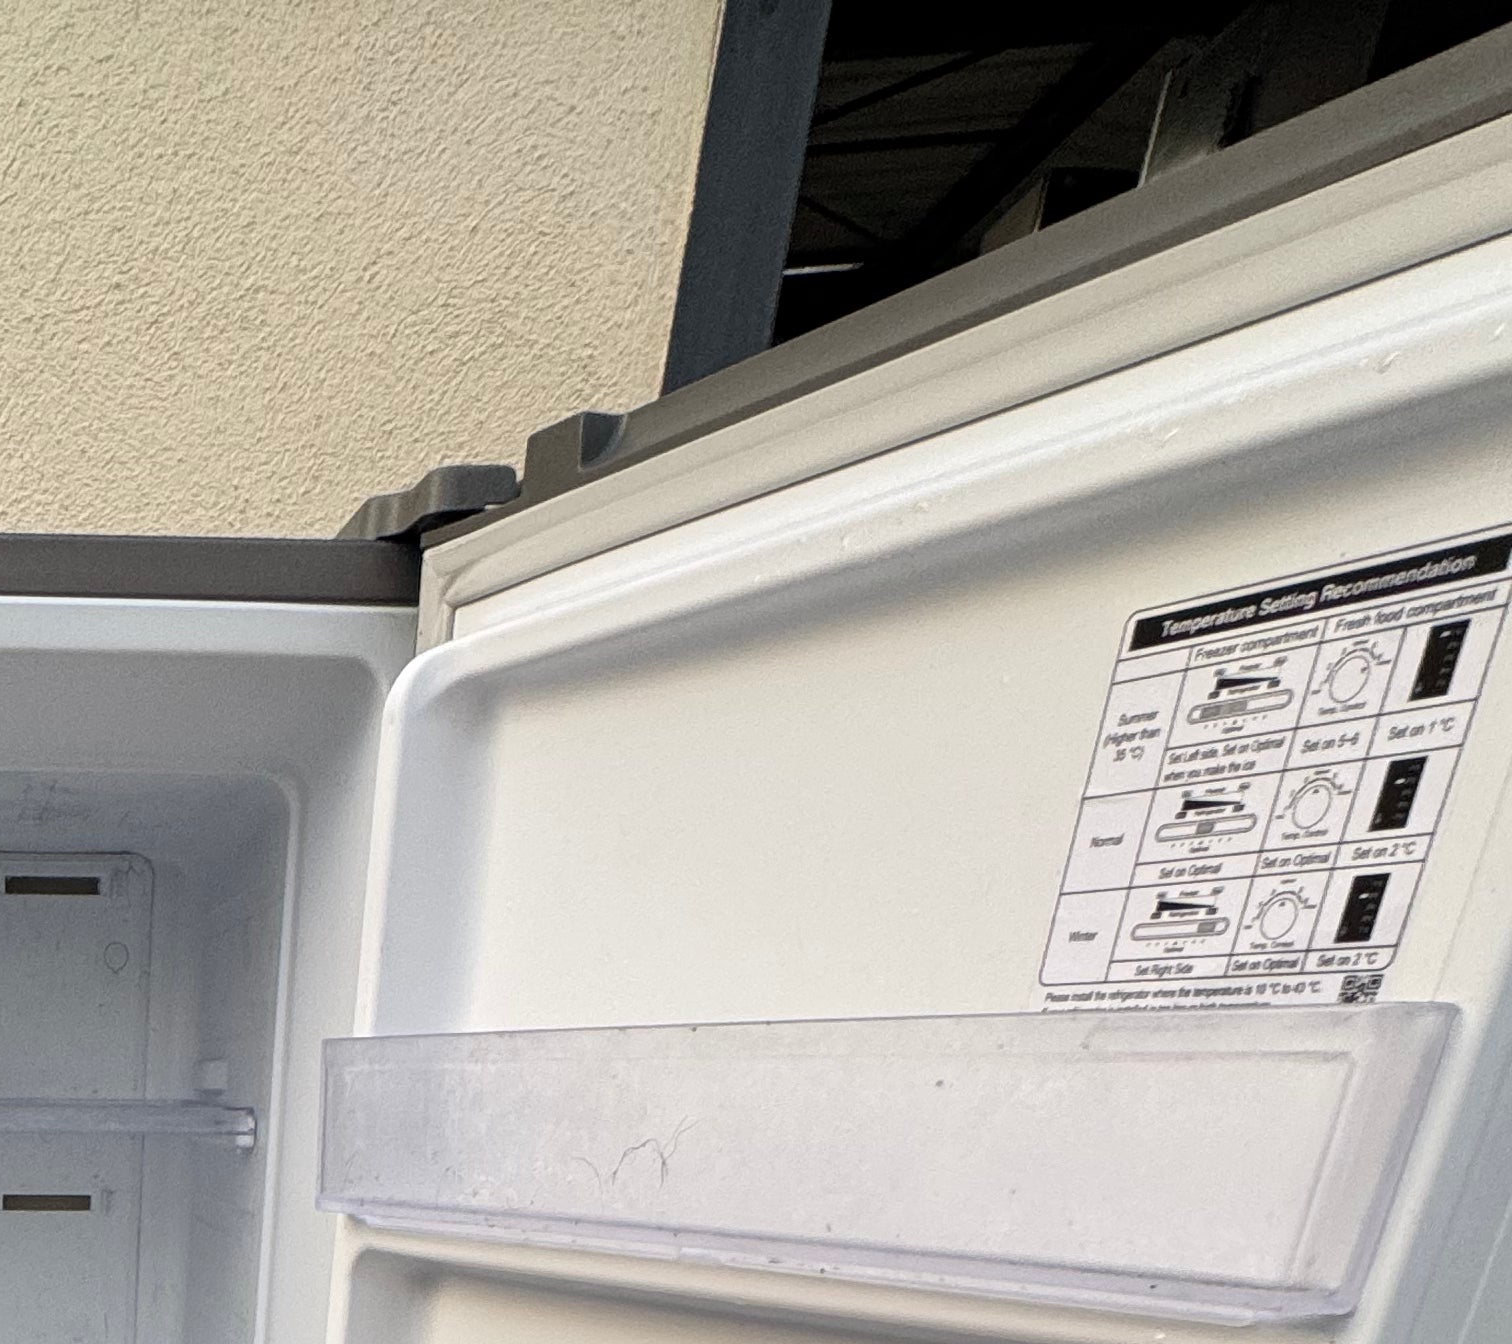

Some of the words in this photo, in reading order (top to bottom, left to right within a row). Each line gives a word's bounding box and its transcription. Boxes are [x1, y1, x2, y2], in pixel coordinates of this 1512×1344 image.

[1160, 605, 1257, 638] Temperature
[1258, 590, 1318, 617] Setting
[1319, 553, 1478, 602] Recommendation
[1334, 613, 1371, 634] Fresh
[1374, 607, 1405, 625] food
[1406, 587, 1499, 617] compartment
[1194, 644, 1239, 662] Freezer
[1240, 625, 1319, 651] compartment
[1301, 737, 1321, 754] Set
[1322, 738, 1336, 750] on
[1388, 725, 1409, 742] Set
[1409, 724, 1425, 737] on
